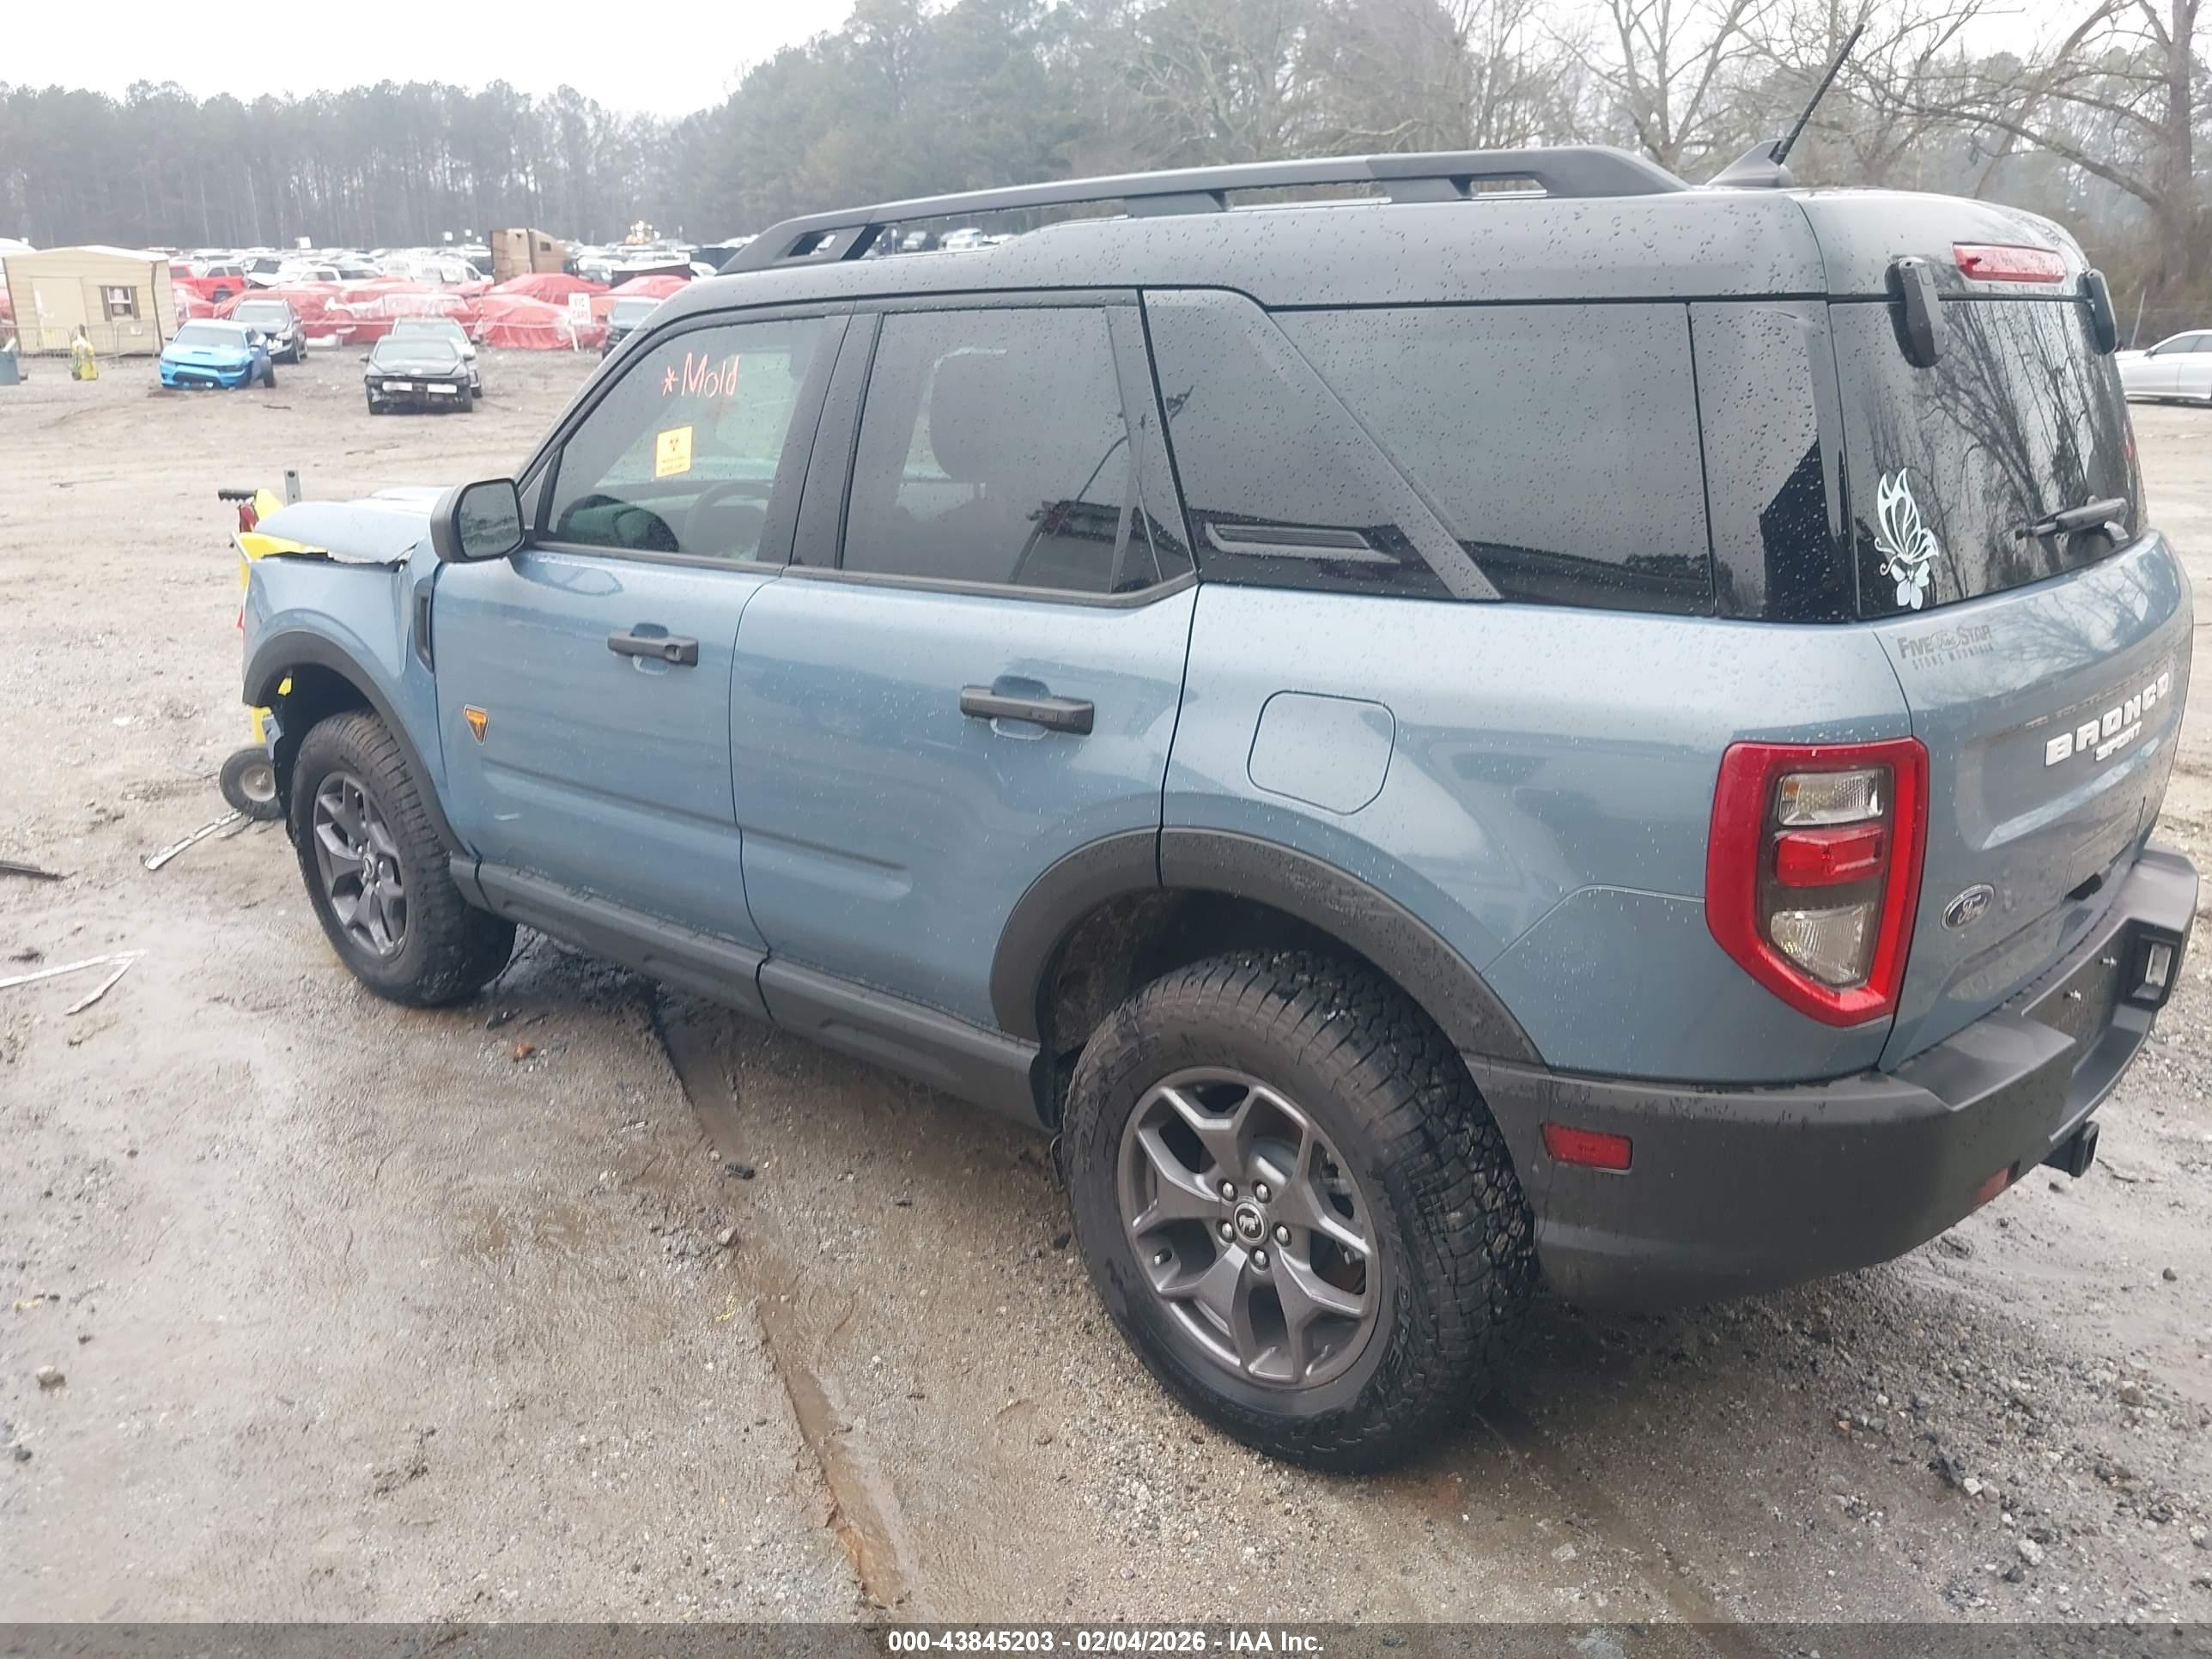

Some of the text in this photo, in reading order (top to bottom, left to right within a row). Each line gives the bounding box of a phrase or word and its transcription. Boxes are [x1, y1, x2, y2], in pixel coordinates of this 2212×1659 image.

[1897, 636, 1935, 659] FIVE
[1956, 624, 1992, 646] STAR
[2045, 672, 2169, 767] BRONCO
